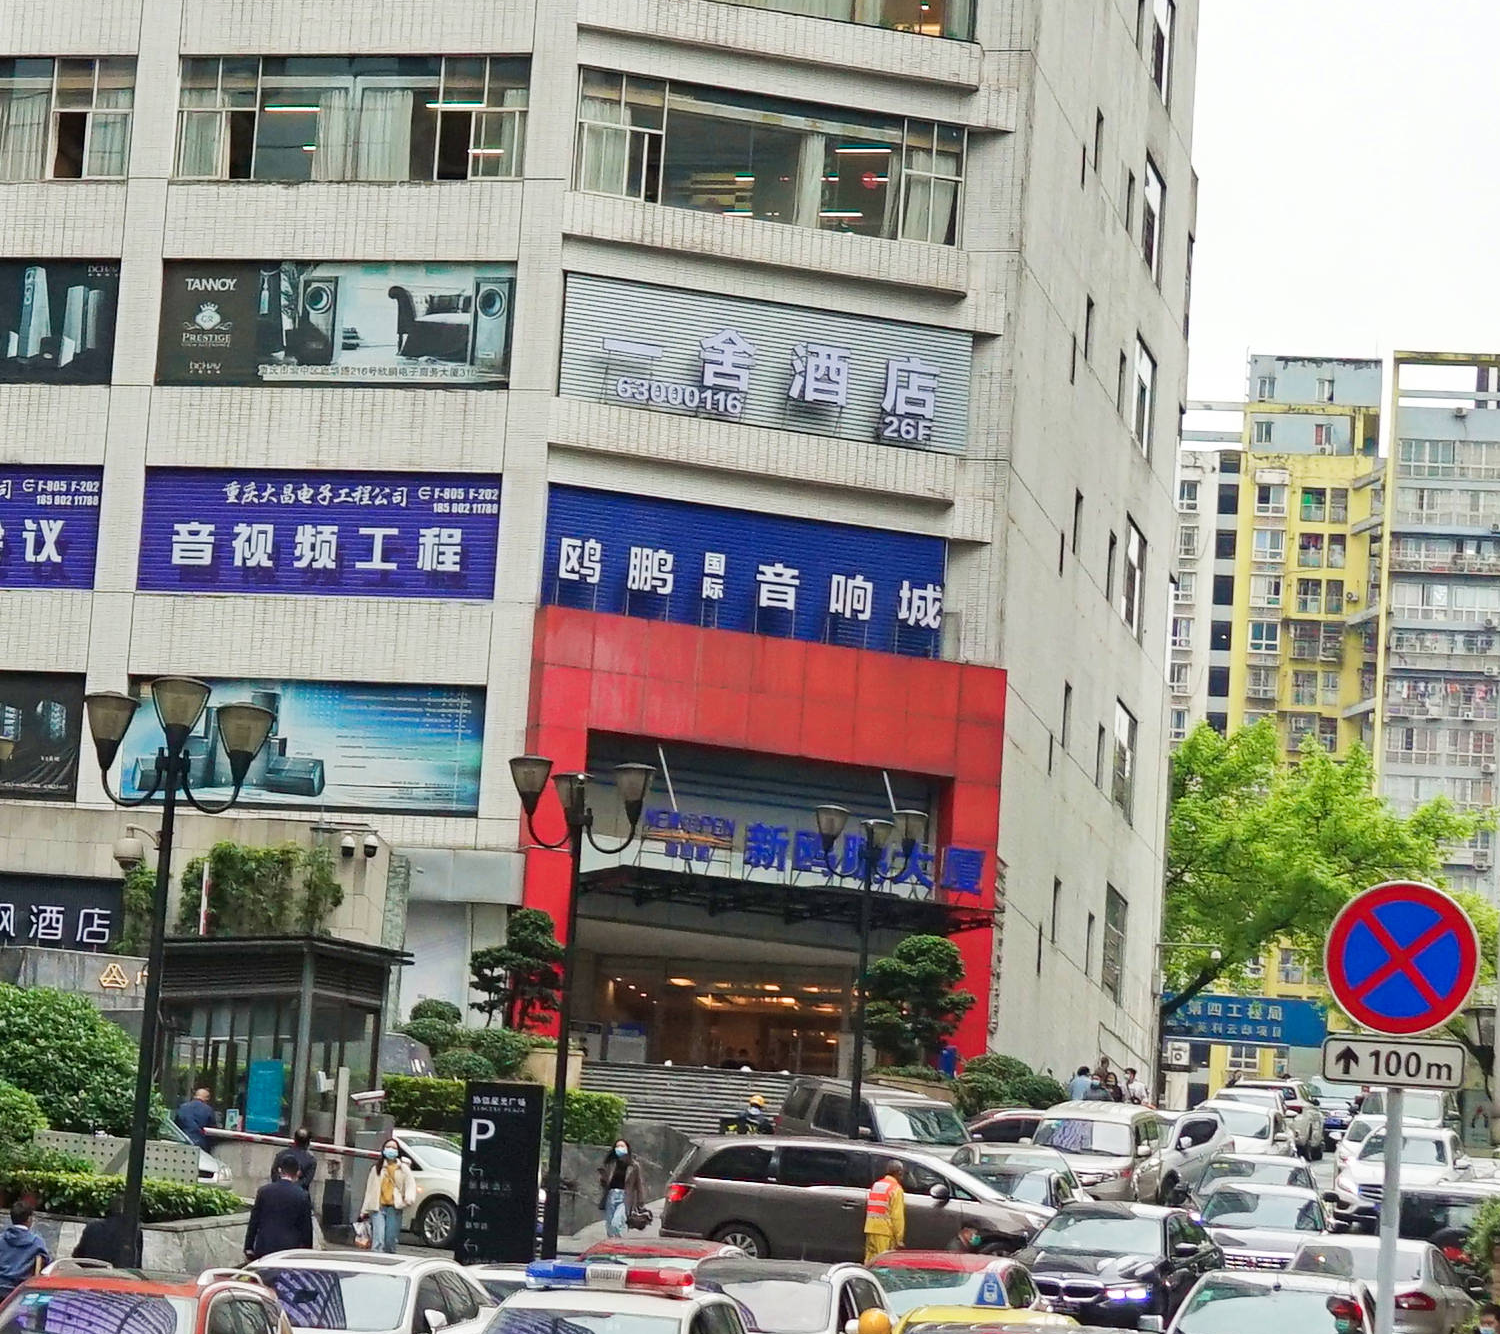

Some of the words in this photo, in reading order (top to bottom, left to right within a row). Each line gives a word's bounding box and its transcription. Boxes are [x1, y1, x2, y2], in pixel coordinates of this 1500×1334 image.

[184, 277, 238, 292] TANNOY
[602, 329, 941, 420] 一舍酒店
[616, 376, 744, 415] 63000116
[882, 416, 933, 442] 26F
[222, 481, 408, 508] 重庆大昌电子工程公司
[171, 522, 462, 571] 音视频工程
[469, 1118, 496, 1152] P
